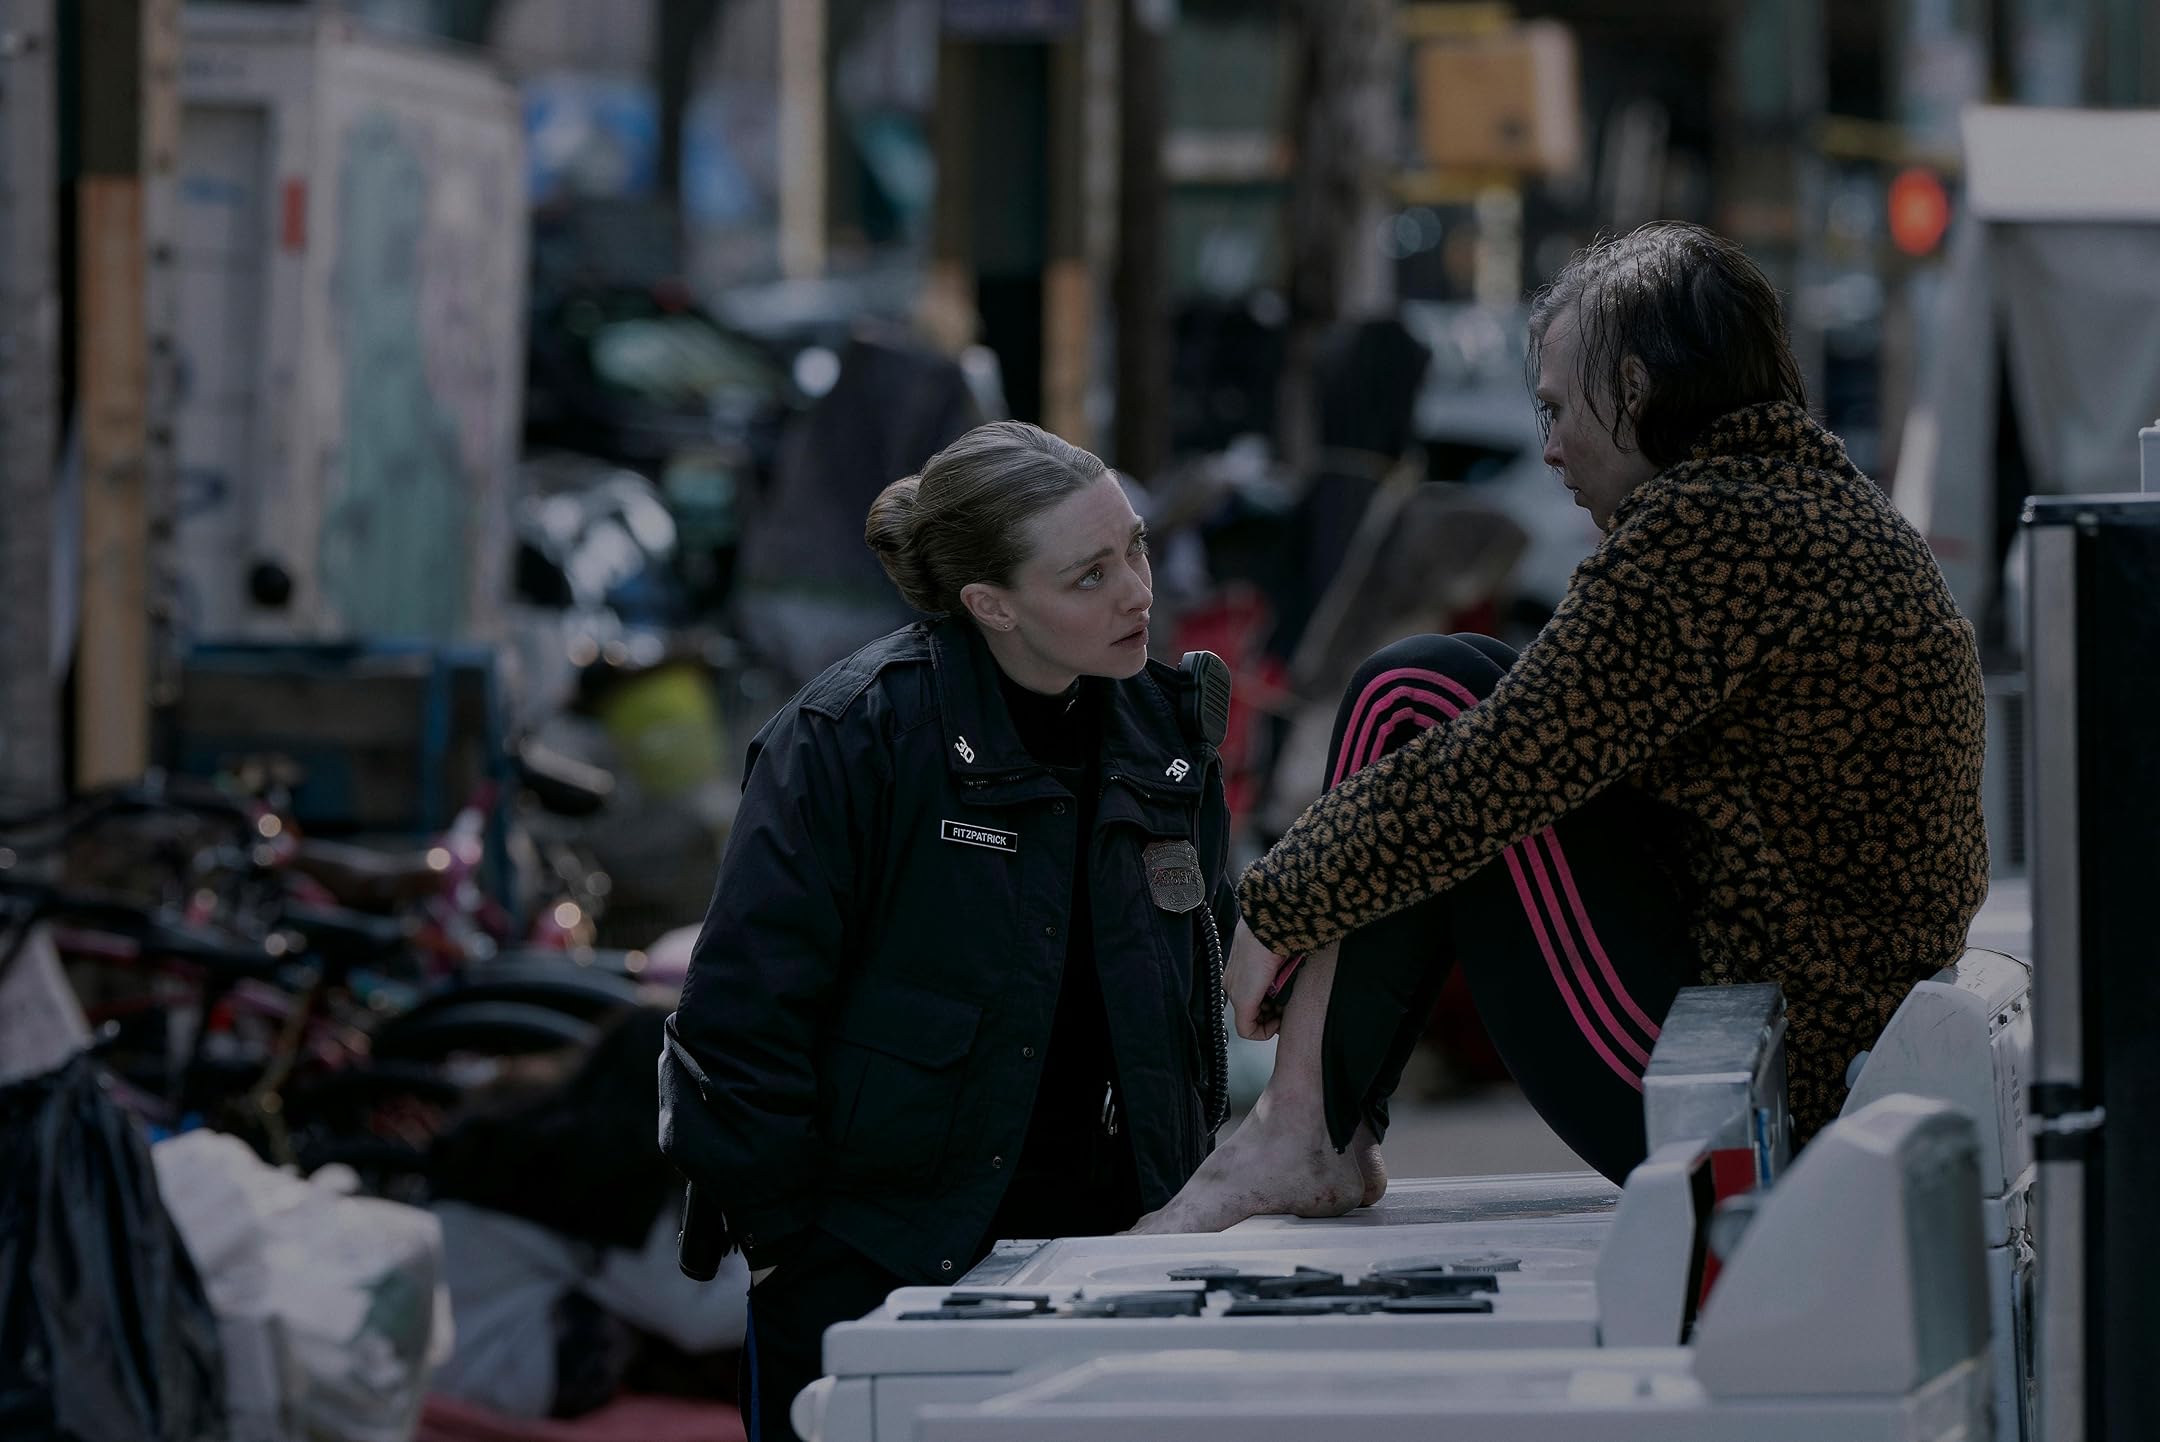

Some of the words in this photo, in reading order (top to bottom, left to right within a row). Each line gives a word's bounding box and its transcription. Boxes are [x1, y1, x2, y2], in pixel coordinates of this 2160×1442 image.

[954, 735, 975, 764] 30
[1165, 758, 1190, 783] 30
[952, 827, 1007, 846] FITZPATRICK
